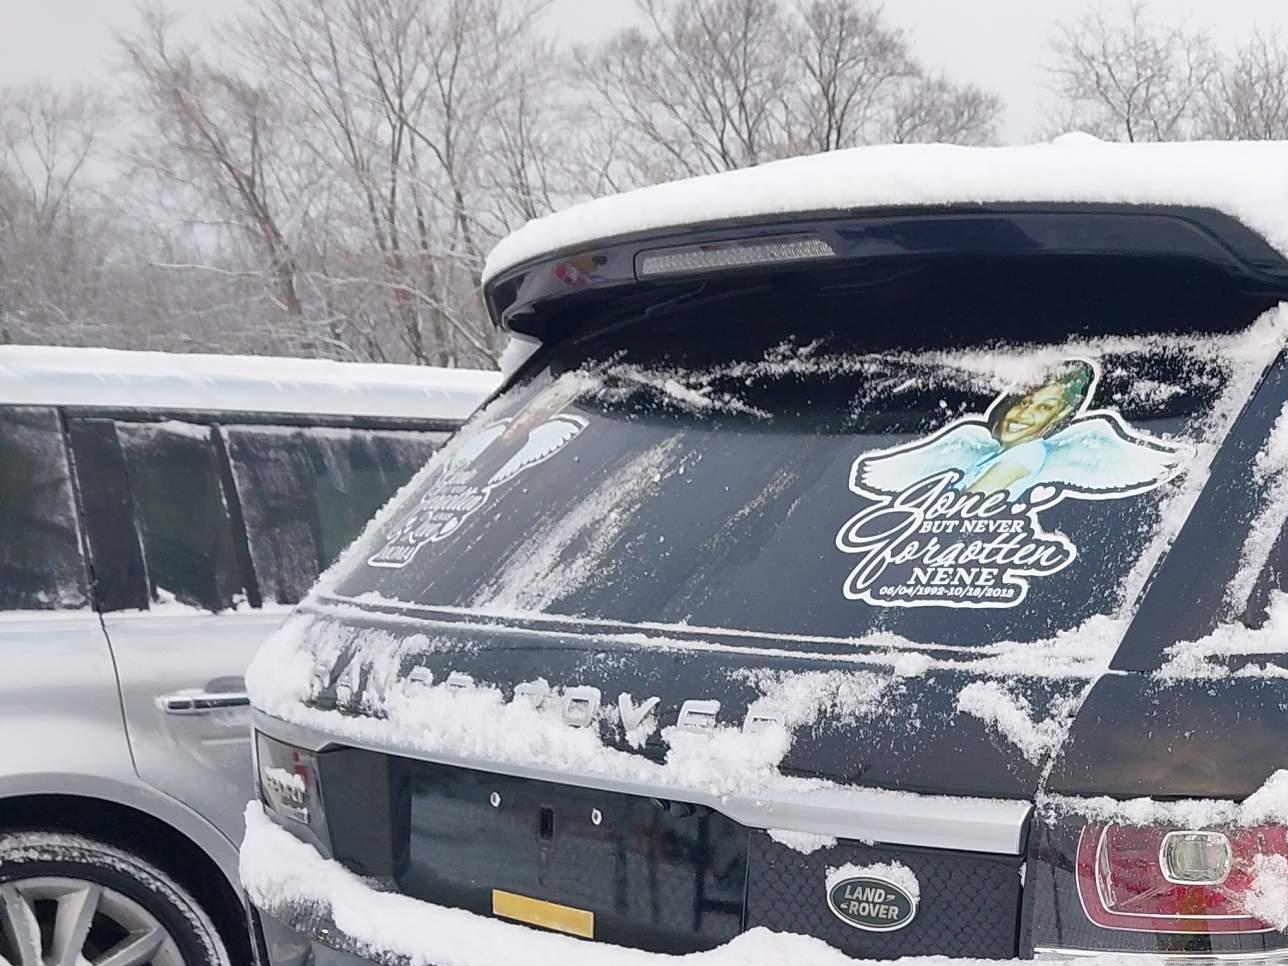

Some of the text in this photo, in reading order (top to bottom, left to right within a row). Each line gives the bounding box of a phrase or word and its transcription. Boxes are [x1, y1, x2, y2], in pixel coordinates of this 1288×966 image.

[893, 471, 1007, 520] Gone
[918, 519, 1025, 534] BUT NEVER
[906, 567, 999, 587] NENE
[844, 885, 886, 903] LAND
[848, 901, 899, 920] ROVER
